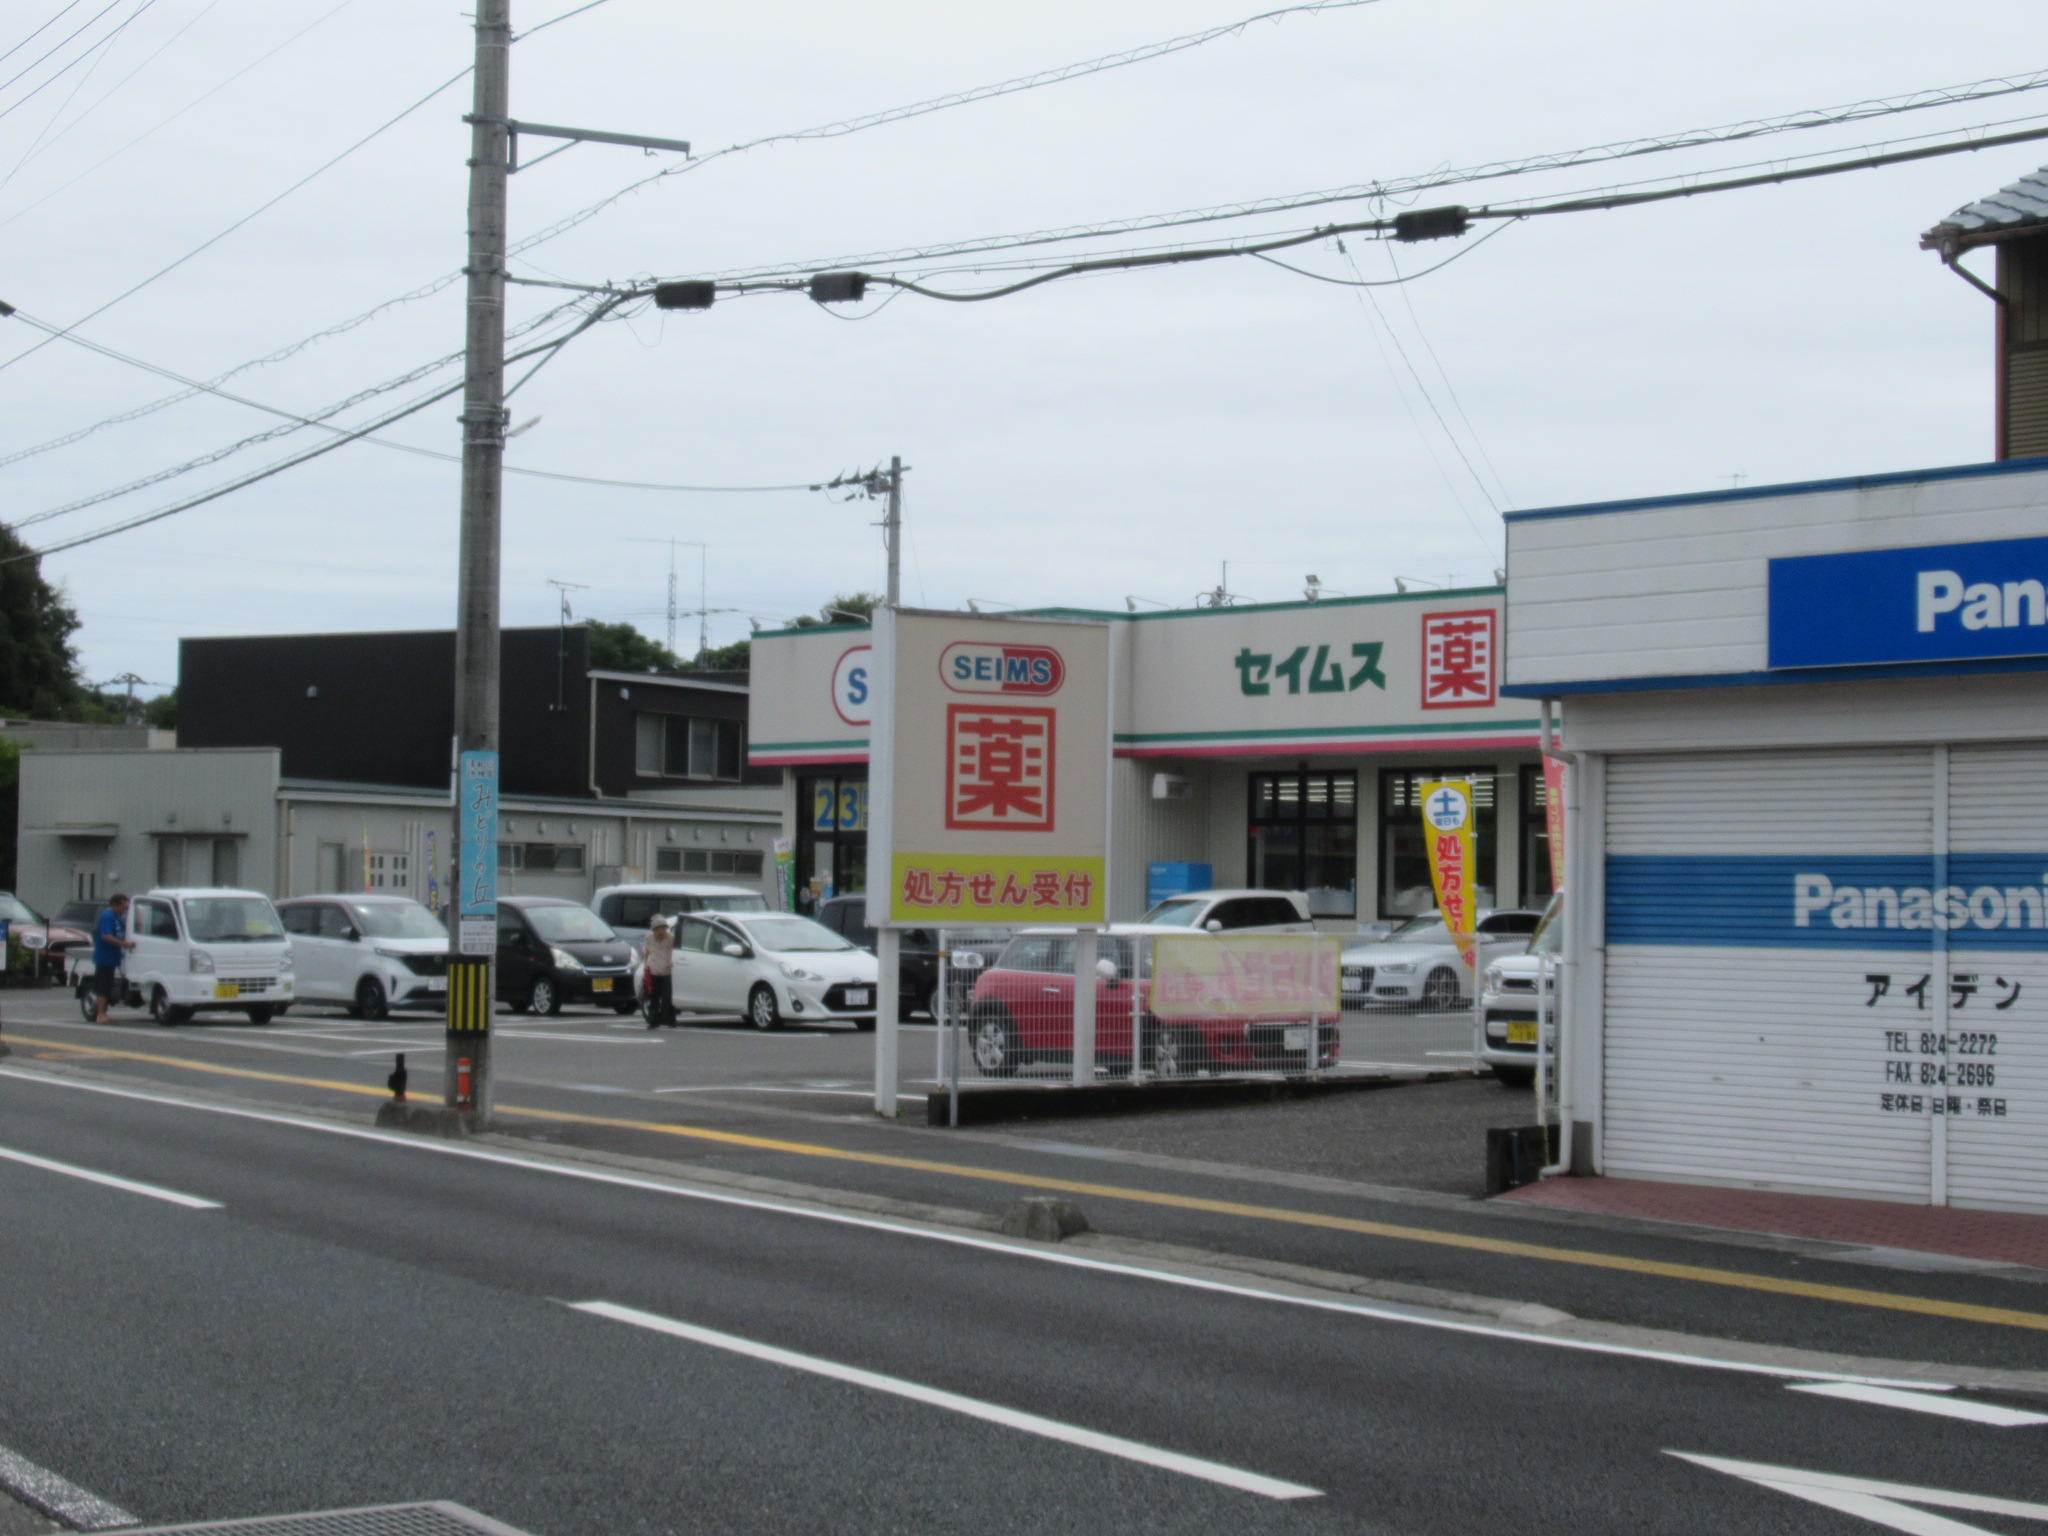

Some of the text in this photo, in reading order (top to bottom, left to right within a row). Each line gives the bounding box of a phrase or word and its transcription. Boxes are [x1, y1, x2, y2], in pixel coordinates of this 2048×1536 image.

[1917, 570, 2048, 632] Pan
[952, 654, 1052, 685] SEIMS
[1234, 641, 1386, 697] セイムス
[1429, 619, 1488, 699] 薬
[956, 717, 1045, 819] 薬
[1433, 791, 1460, 817] 土
[903, 869, 1093, 909] 処方せん受付
[1865, 973, 2022, 1011] アイデン
[1885, 1031, 1998, 1056] TEL 824-2272
[1886, 1061, 1995, 1087] FAX 824-2696
[1881, 1093, 1923, 1113] 定休日
